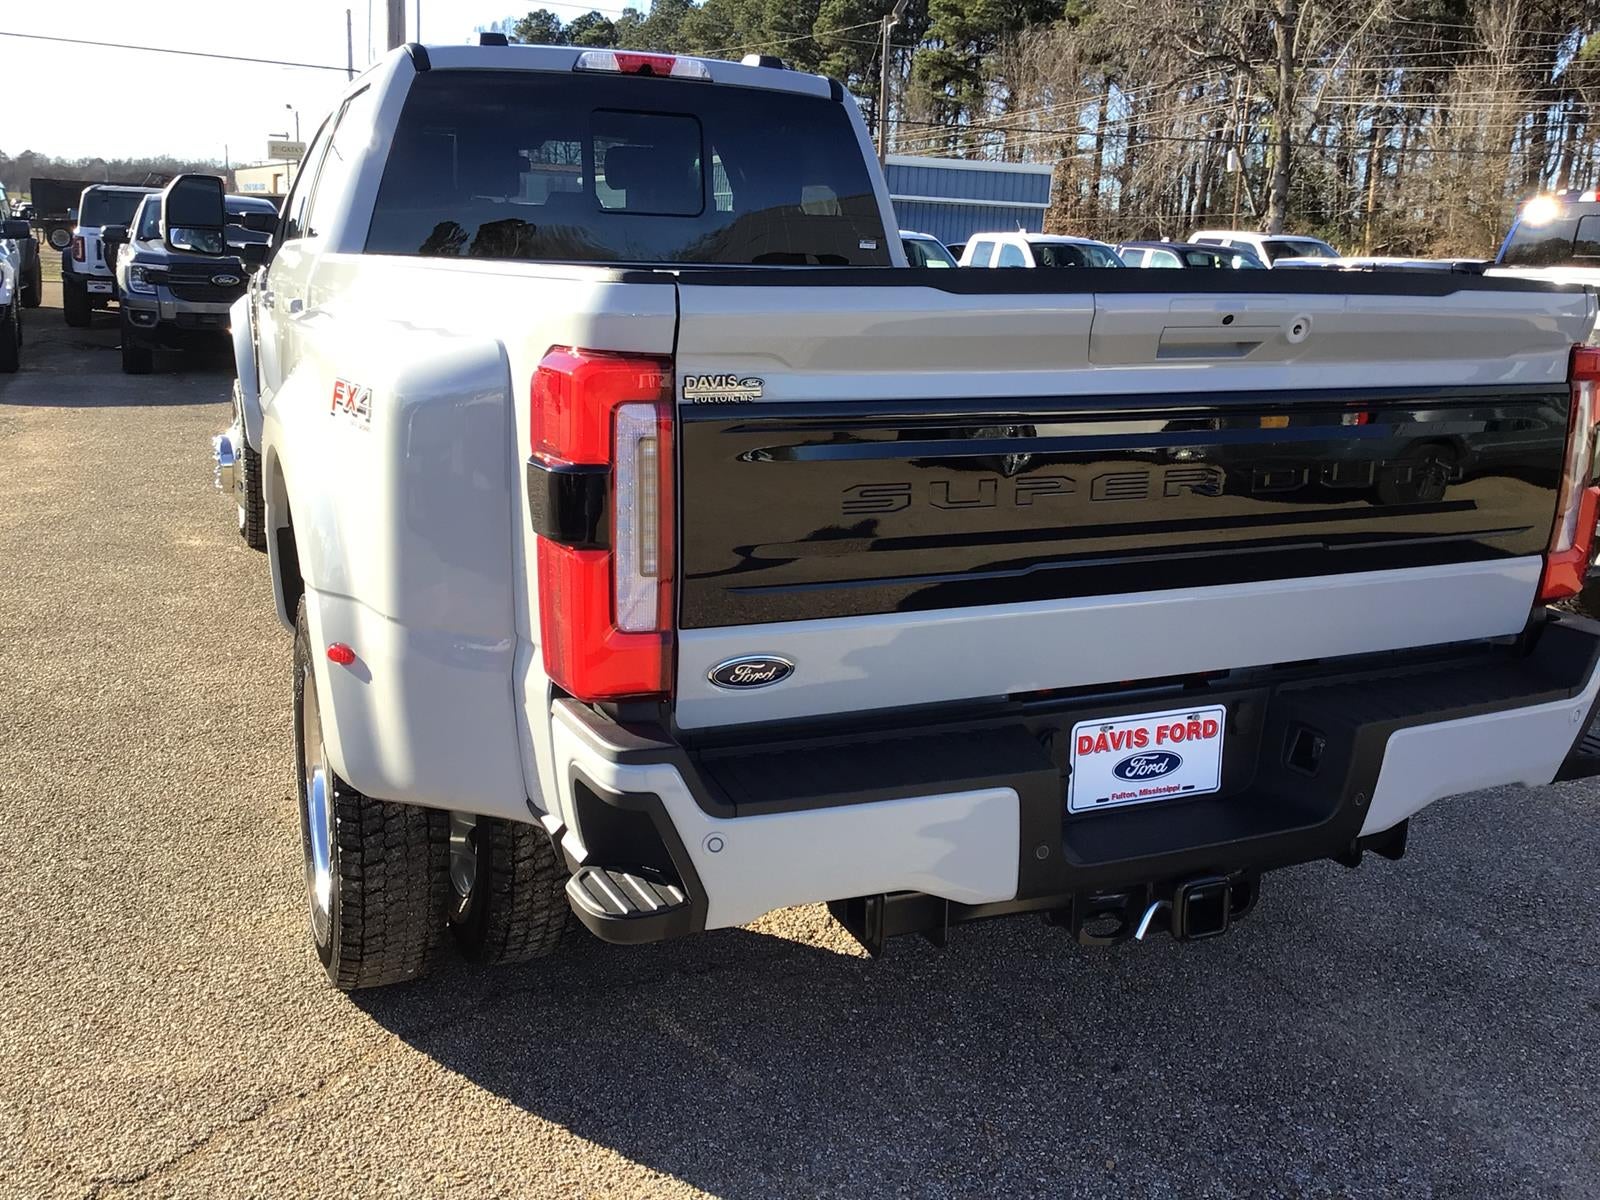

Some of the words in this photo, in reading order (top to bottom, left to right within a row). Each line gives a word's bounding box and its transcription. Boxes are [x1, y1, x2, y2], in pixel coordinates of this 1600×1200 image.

[684, 374, 738, 390] DAVIS
[330, 377, 372, 423] FX4
[842, 467, 1226, 515] SUPER
[729, 663, 777, 682] Ford
[1077, 727, 1151, 756] DAVIS
[1155, 719, 1219, 745] FORD
[1125, 754, 1170, 777] Ford
[1111, 791, 1138, 801] Fulton,
[1138, 783, 1181, 797] Mississippi
